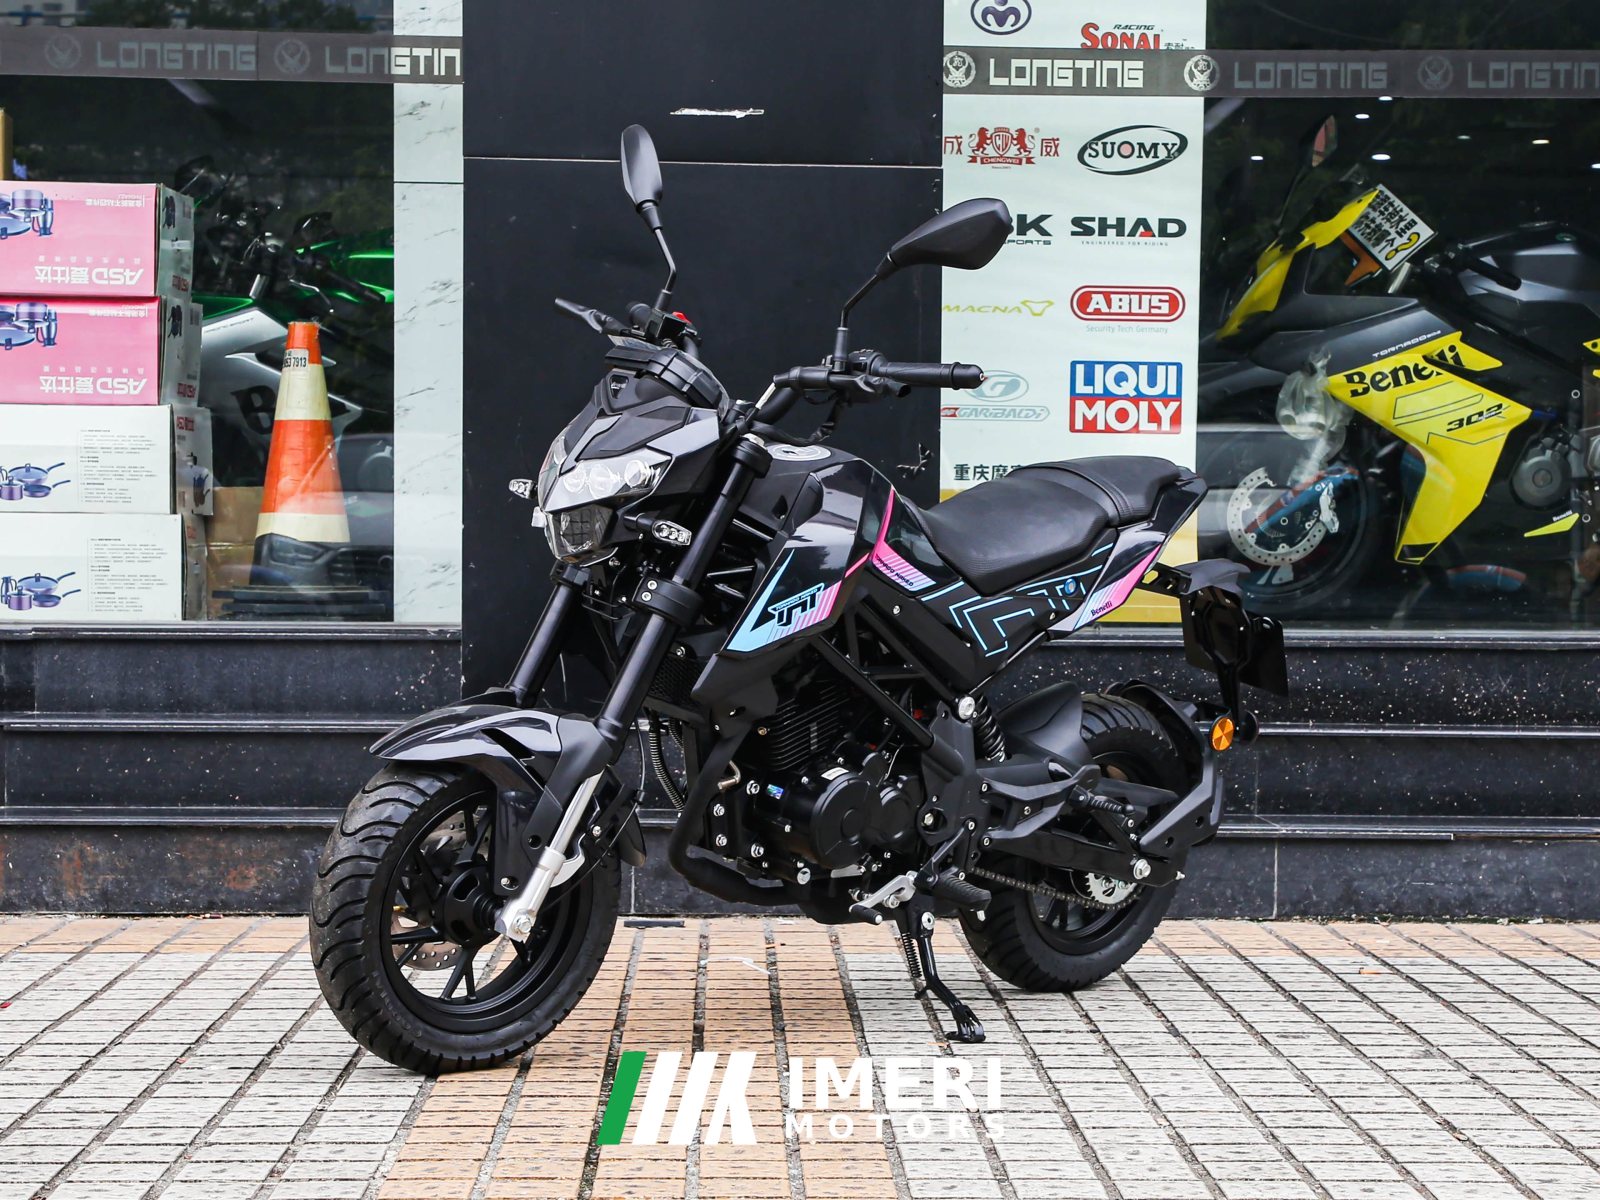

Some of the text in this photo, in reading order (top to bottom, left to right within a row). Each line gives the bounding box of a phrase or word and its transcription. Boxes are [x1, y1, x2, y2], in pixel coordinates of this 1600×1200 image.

[97, 41, 257, 71] LONGTING
[989, 58, 1144, 88] LONGTING
[1234, 62, 1388, 89] LONGTING
[1088, 140, 1178, 160] SUOMY
[1012, 213, 1053, 237] K
[1070, 216, 1187, 238] SHAD
[92, 267, 144, 285] ASD
[941, 304, 1022, 313] MACNA
[1086, 293, 1170, 314] ABUS
[1086, 324, 1168, 334] Security Tech Germany
[97, 377, 147, 395] ASD
[1075, 362, 1177, 397] LIQUI
[1074, 399, 1180, 432] MOLY
[1446, 403, 1503, 432] 302
[1091, 600, 1113, 617] Benelli
